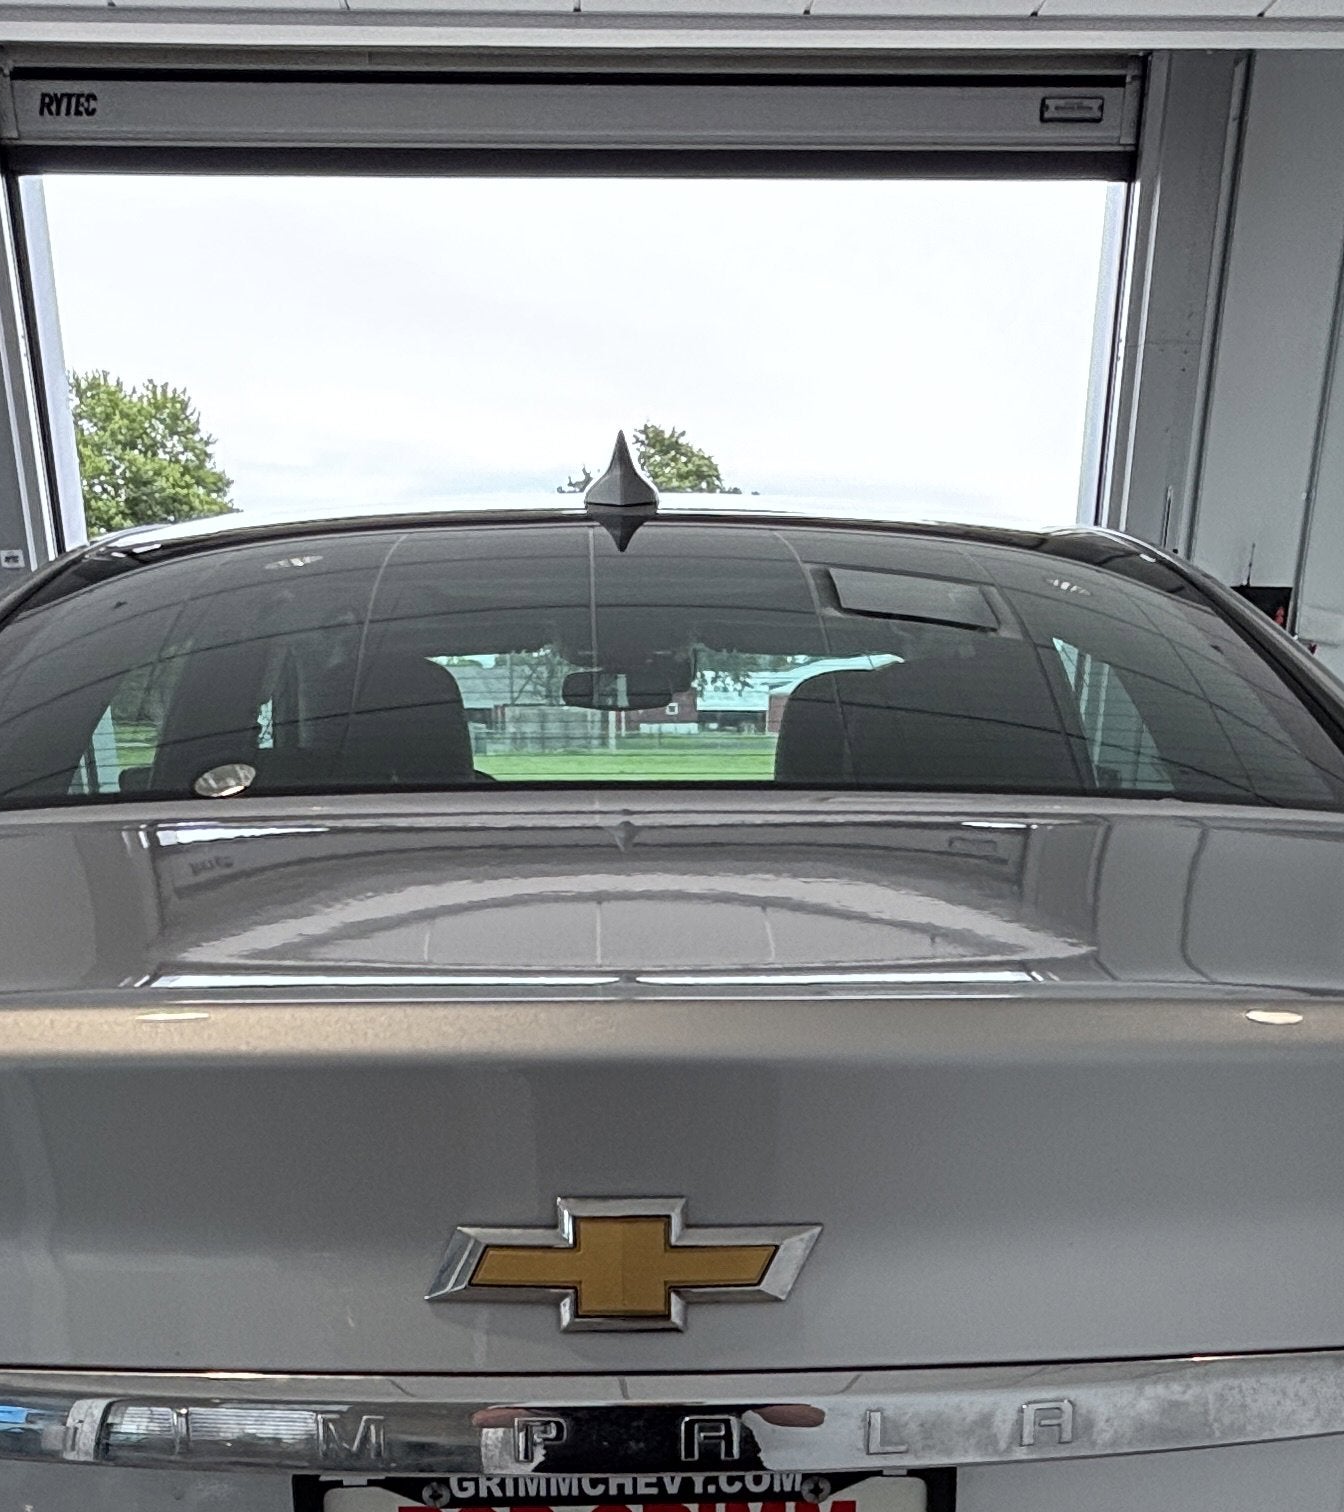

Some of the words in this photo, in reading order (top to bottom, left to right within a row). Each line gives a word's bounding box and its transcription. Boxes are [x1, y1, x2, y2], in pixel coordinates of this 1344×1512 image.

[38, 92, 98, 117] RYTEC
[172, 1399, 1075, 1464] IMPALA
[448, 1473, 803, 1499] GRIMMCHEVY.COM
